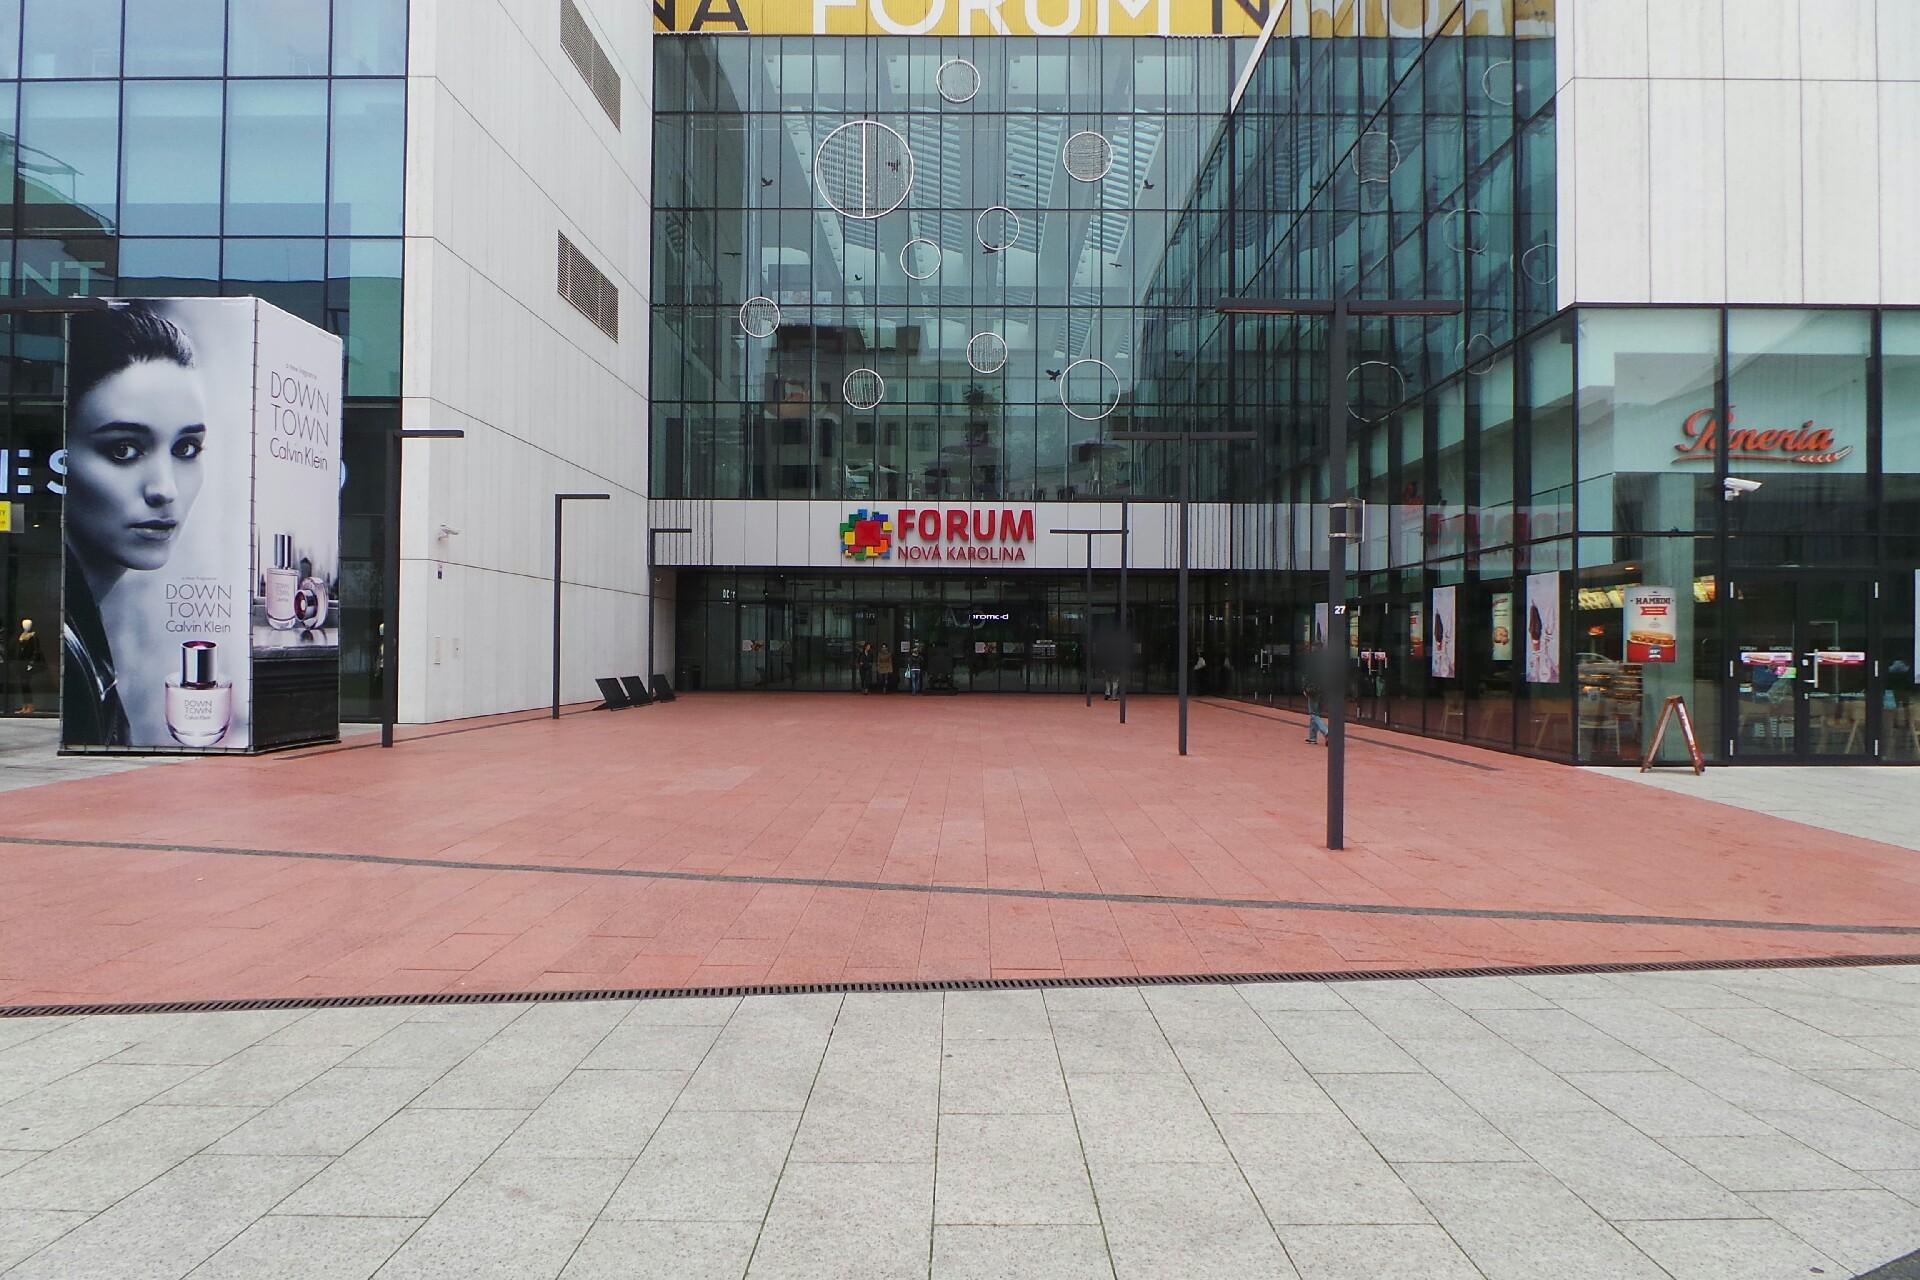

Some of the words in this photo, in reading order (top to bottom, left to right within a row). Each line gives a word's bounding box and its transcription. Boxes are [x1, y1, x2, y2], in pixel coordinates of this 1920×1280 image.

[270, 371, 329, 416] DOWN
[270, 403, 328, 447] TOWN
[270, 437, 303, 464] Calvin
[304, 445, 328, 471] Klein
[898, 509, 1035, 542] FORUM
[898, 544, 942, 561] NOVÁ
[946, 546, 1026, 561] KAROLINA
[166, 584, 232, 600] DOWN
[166, 602, 232, 618] TOWN
[1334, 605, 1346, 614] 27
[165, 620, 202, 633] Calvin
[204, 620, 231, 633] Klein
